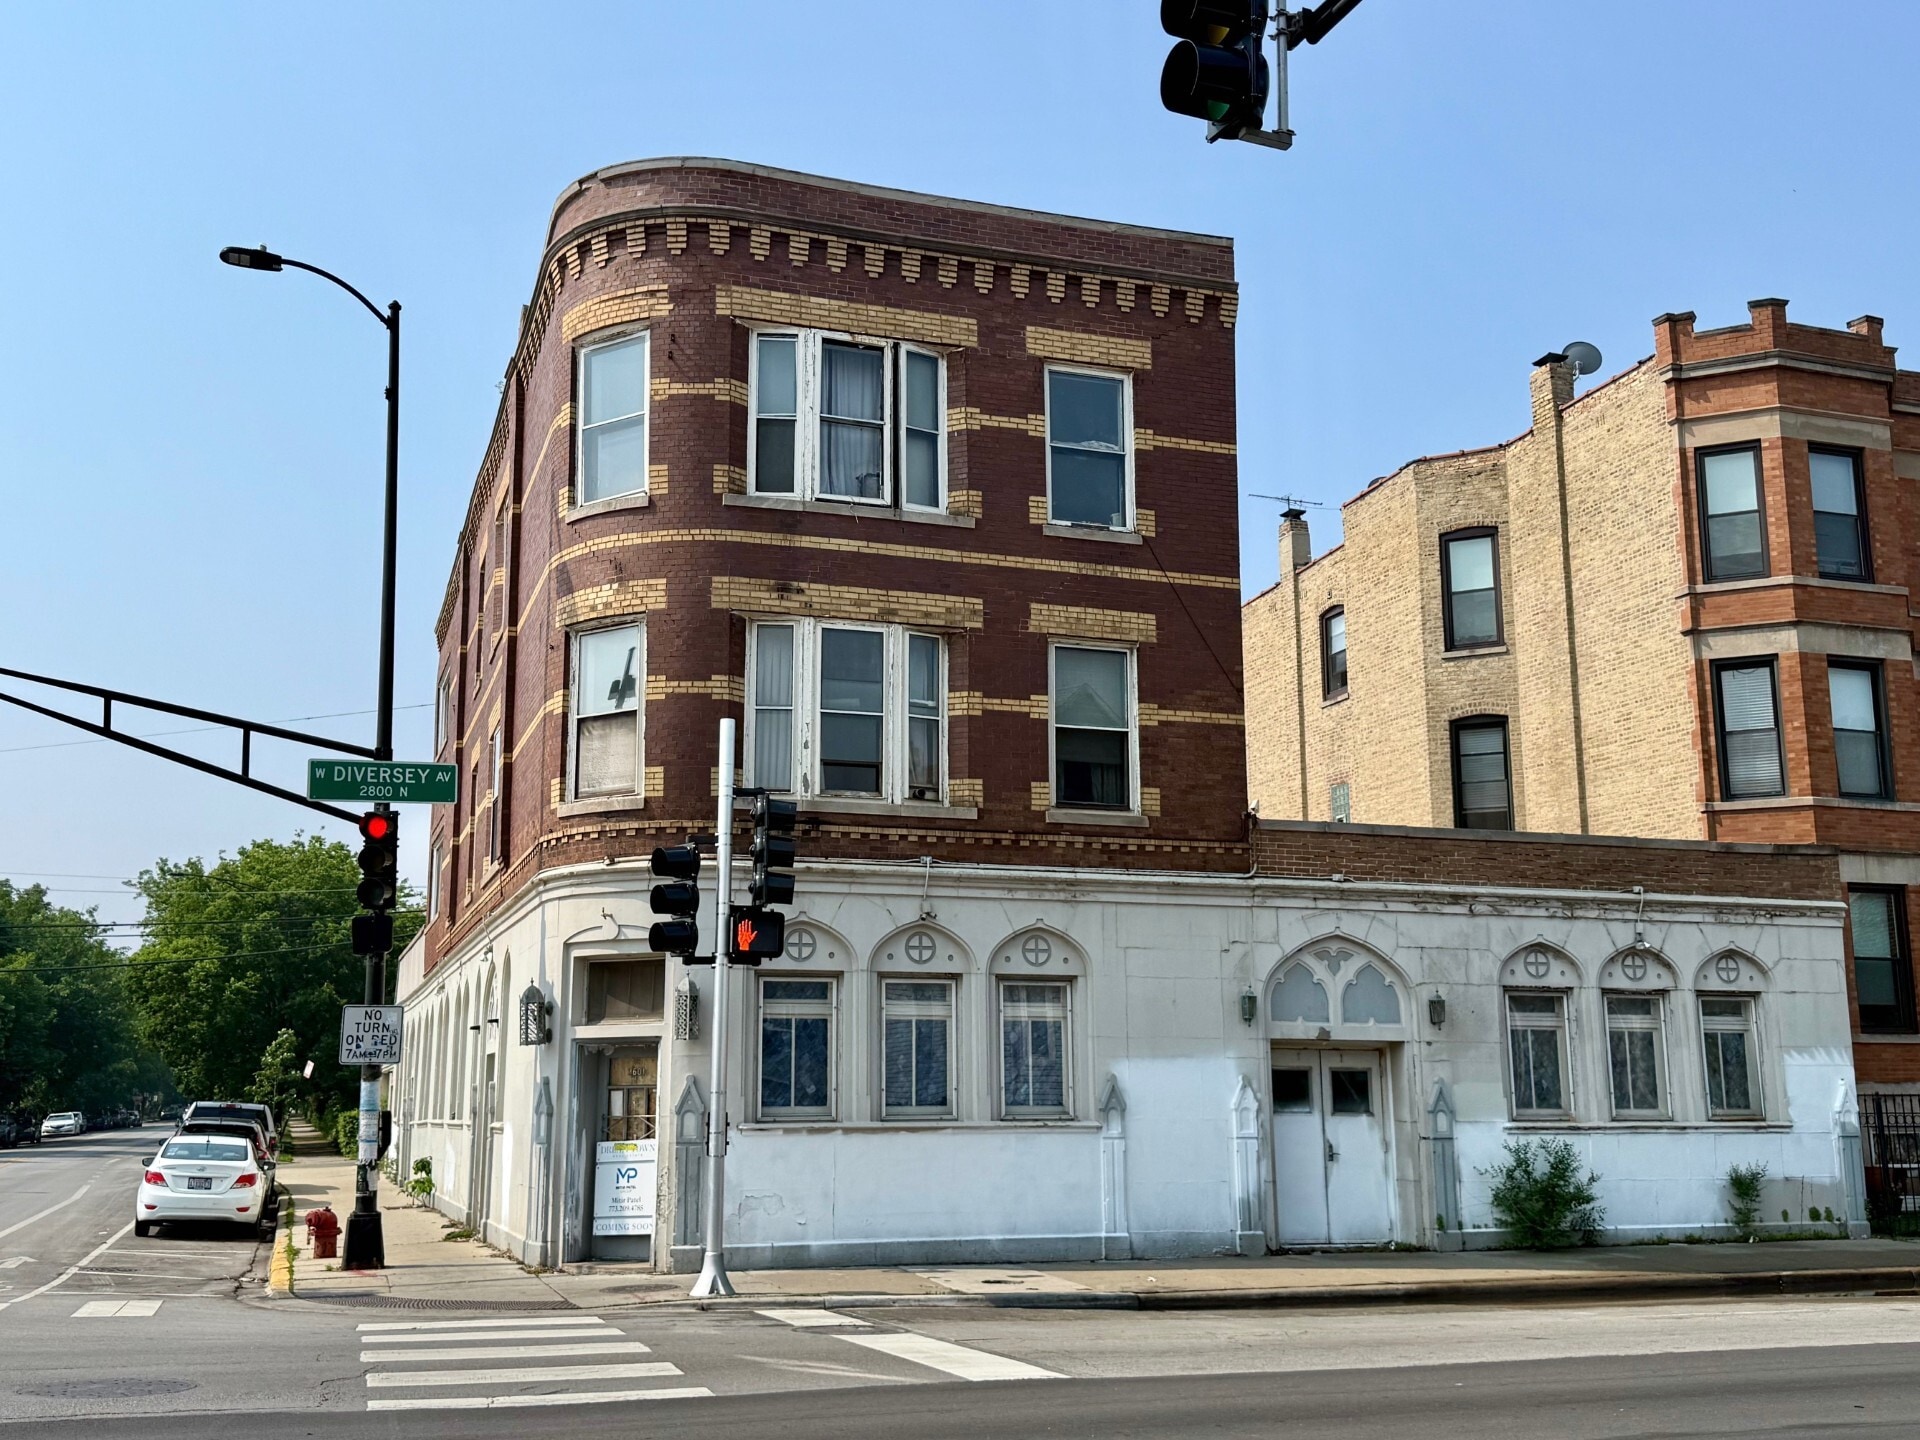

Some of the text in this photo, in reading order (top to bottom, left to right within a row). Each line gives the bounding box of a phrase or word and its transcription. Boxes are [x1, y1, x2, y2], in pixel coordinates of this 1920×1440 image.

[315, 766, 451, 784] W DIVERSEY AV
[359, 785, 408, 797] 2800 N
[364, 1010, 382, 1021] NO
[355, 1022, 390, 1033] TURN
[346, 1034, 364, 1046] ON
[596, 1223, 630, 1231] COMING
